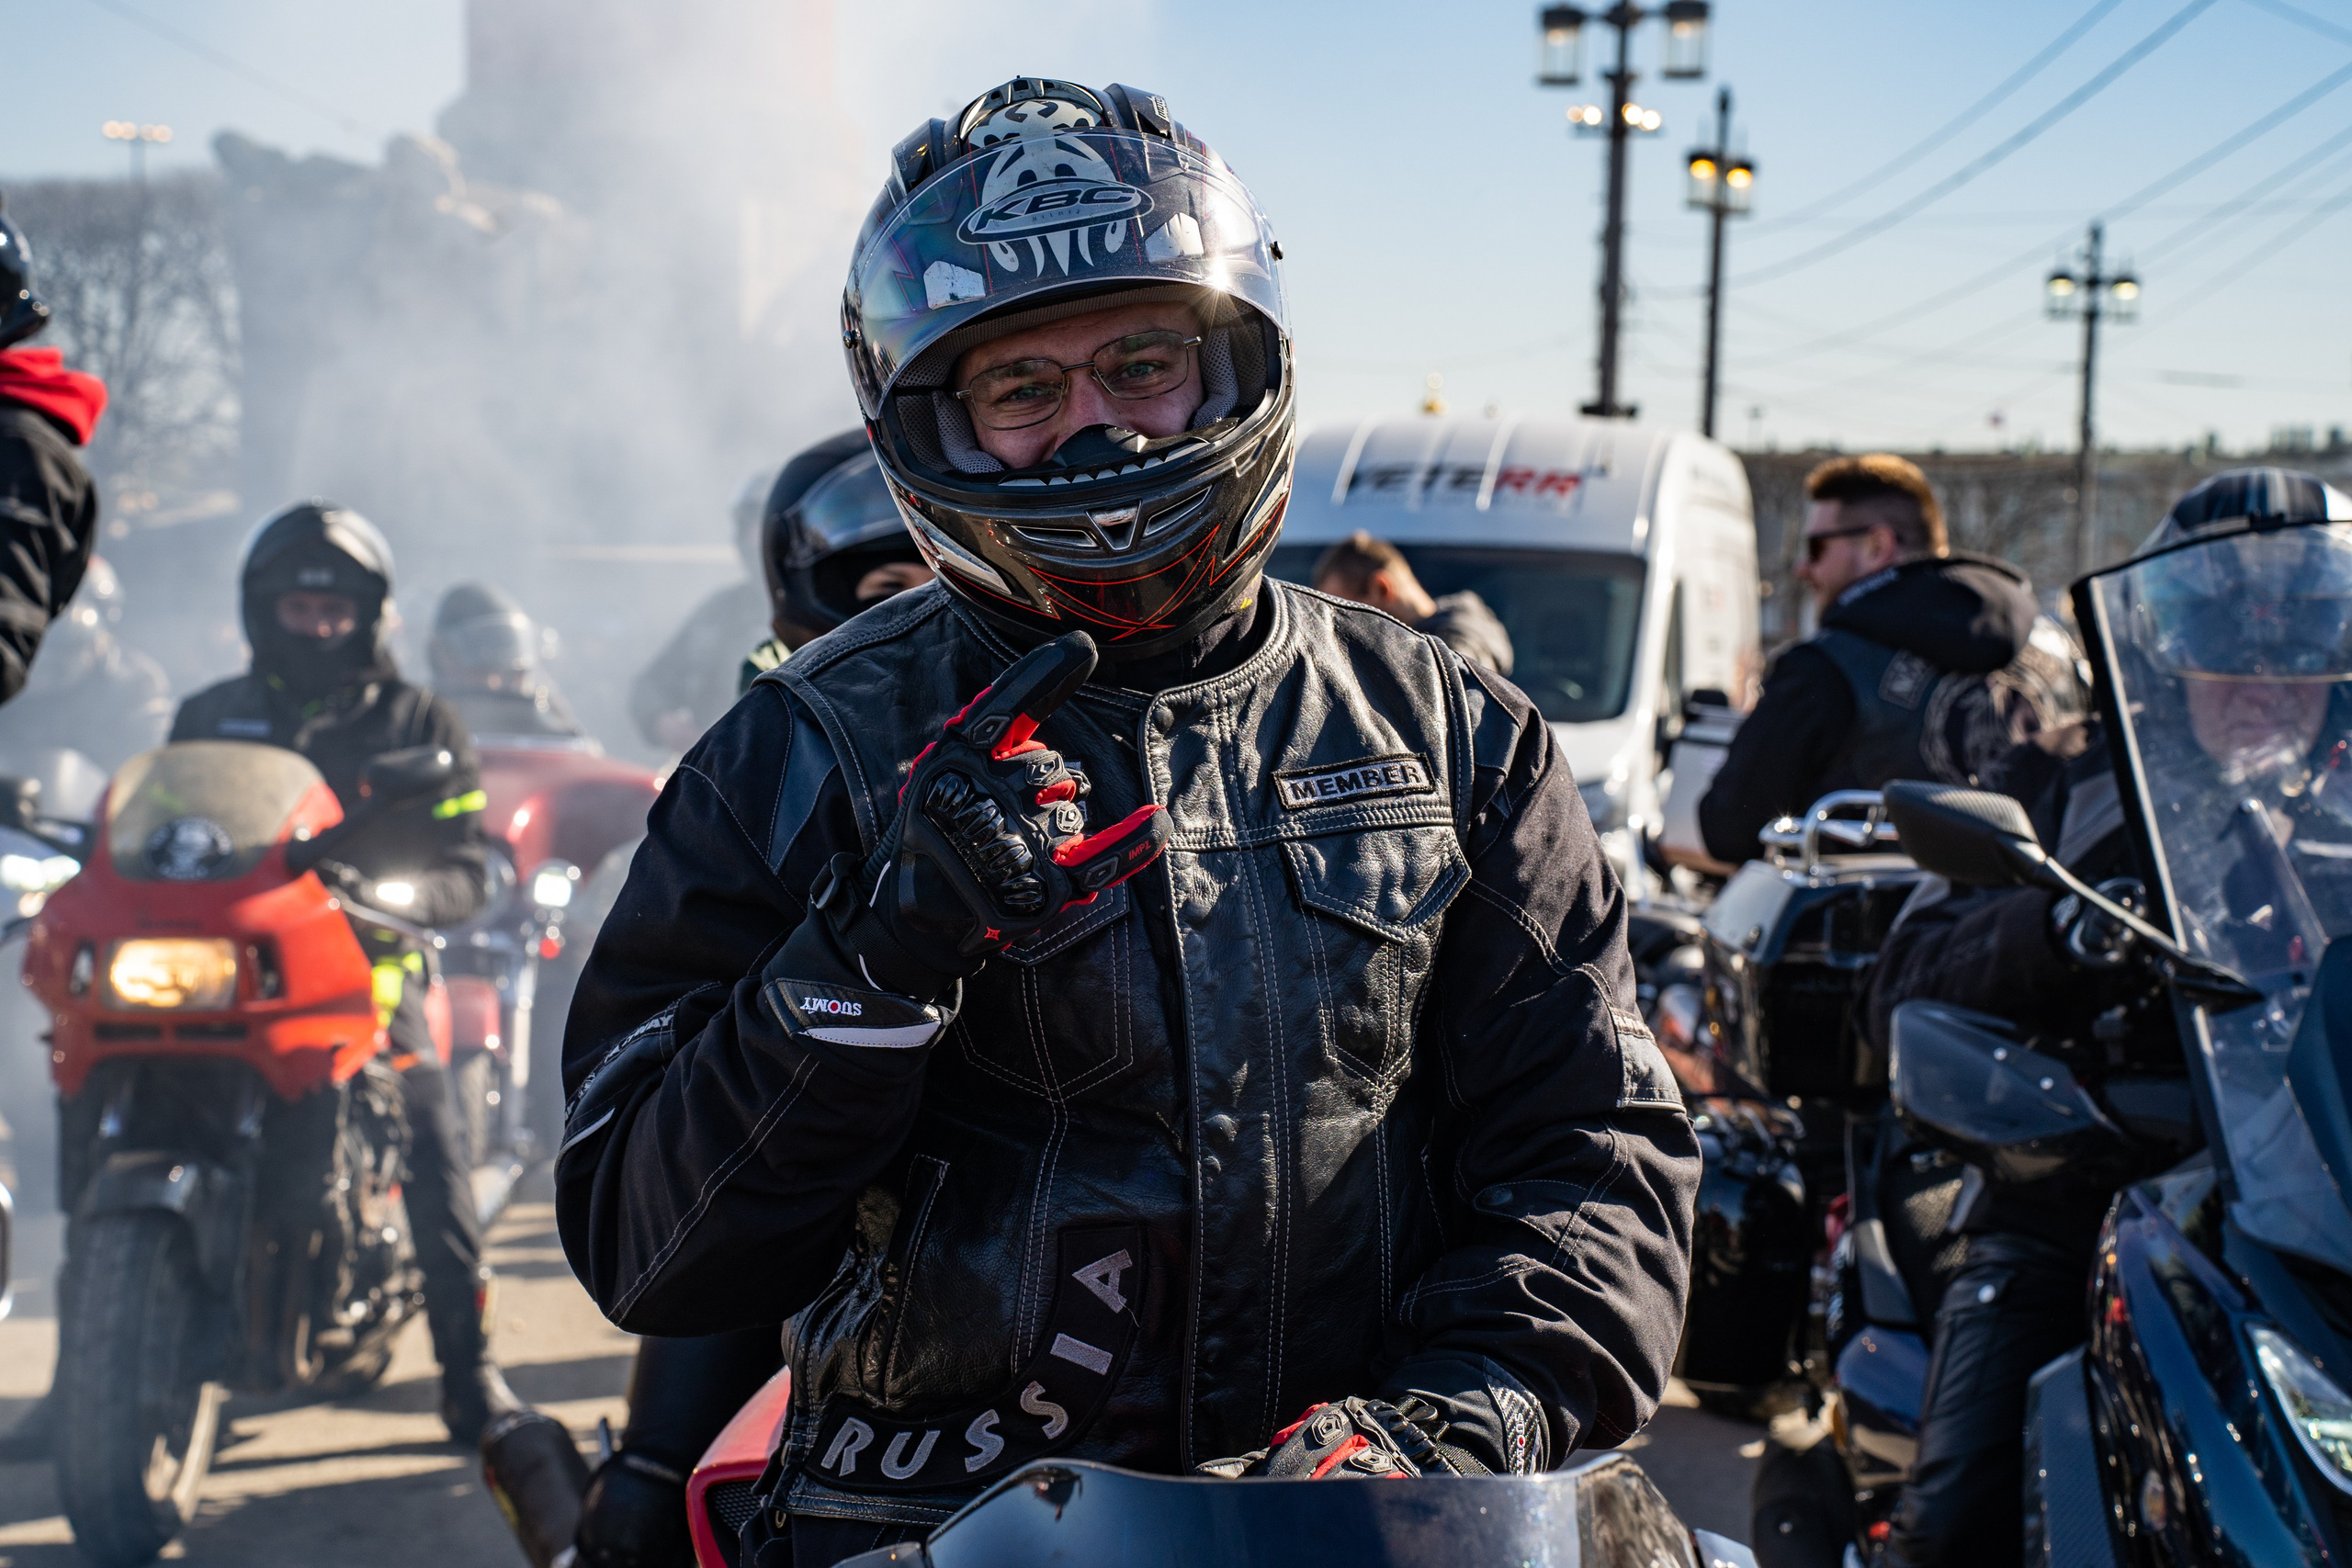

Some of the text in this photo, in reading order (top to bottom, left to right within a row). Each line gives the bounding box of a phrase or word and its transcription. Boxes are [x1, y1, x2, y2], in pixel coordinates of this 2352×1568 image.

[973, 186, 1136, 233] KBC
[1290, 764, 1422, 801] MEMBER
[800, 997, 862, 1016] SUOMY
[821, 1249, 1133, 1481] RUSSIA
